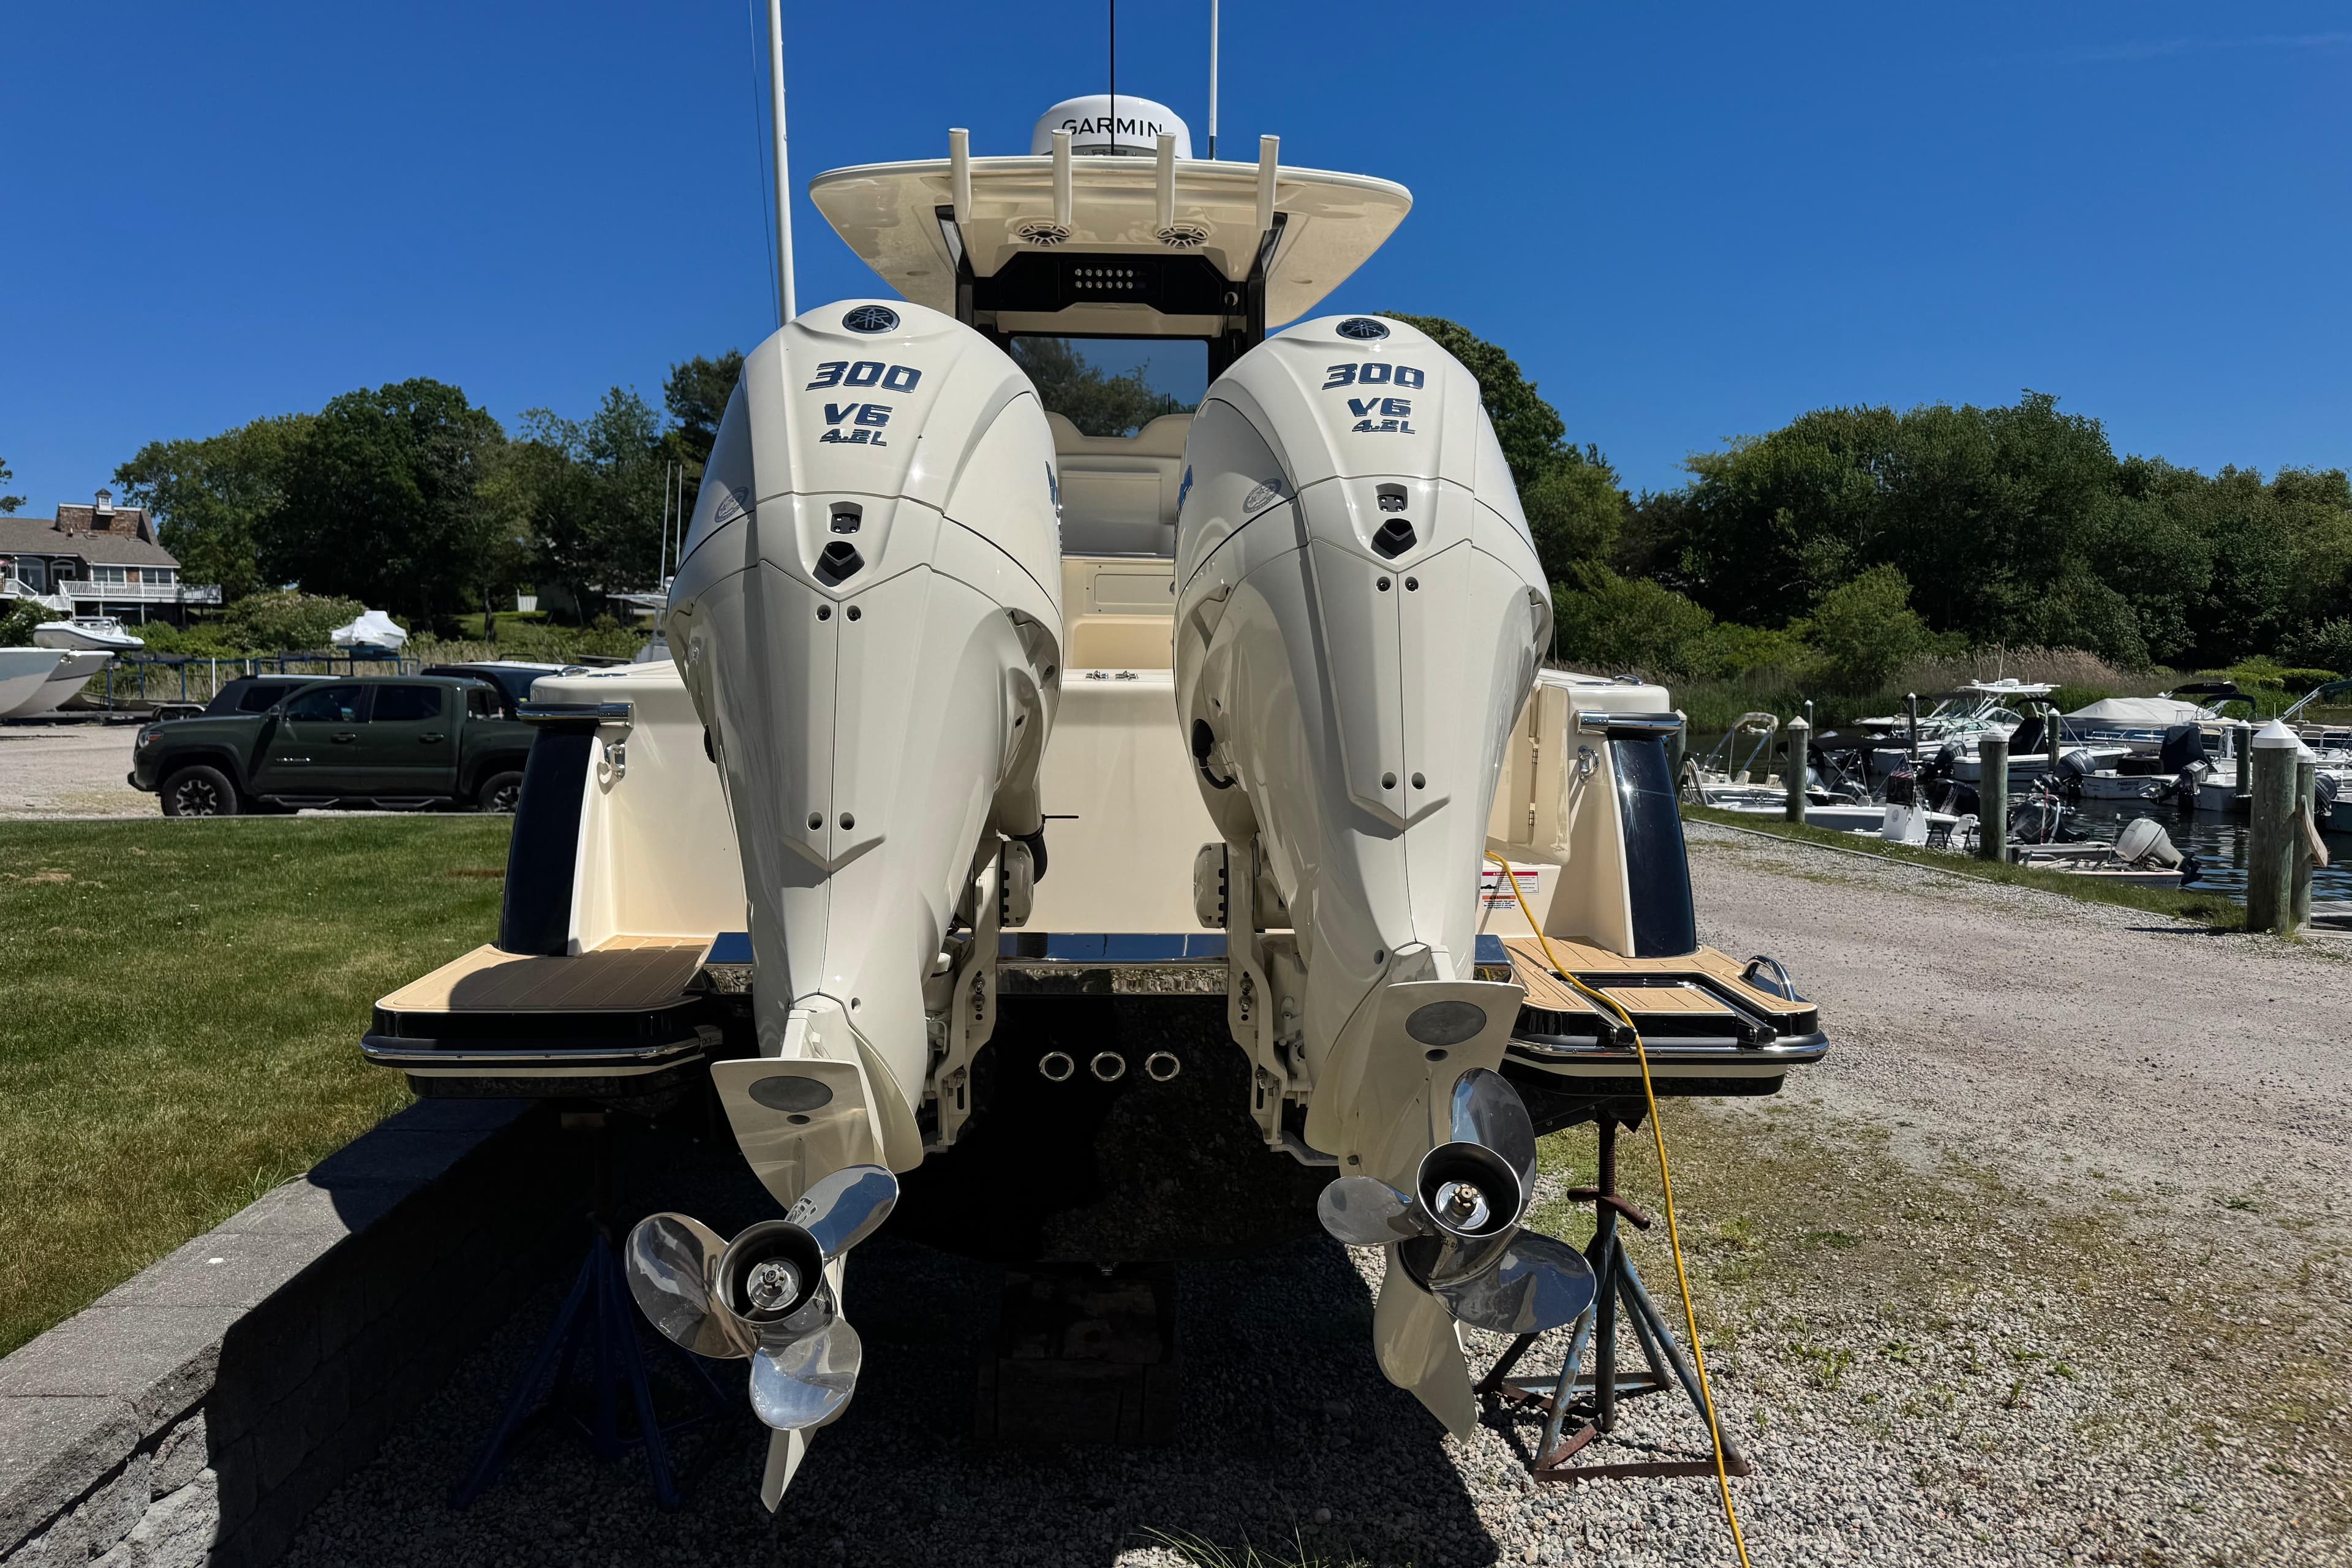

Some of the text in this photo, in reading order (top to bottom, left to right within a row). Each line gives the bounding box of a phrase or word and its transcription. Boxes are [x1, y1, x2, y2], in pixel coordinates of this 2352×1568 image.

[1061, 117, 1163, 137] GARMIN
[805, 361, 922, 394] 300
[1321, 363, 1425, 390] 300
[824, 402, 894, 428] V6
[1348, 397, 1412, 418] V6
[819, 428, 888, 447] 4.2L
[1351, 419, 1416, 435] 4.2L
